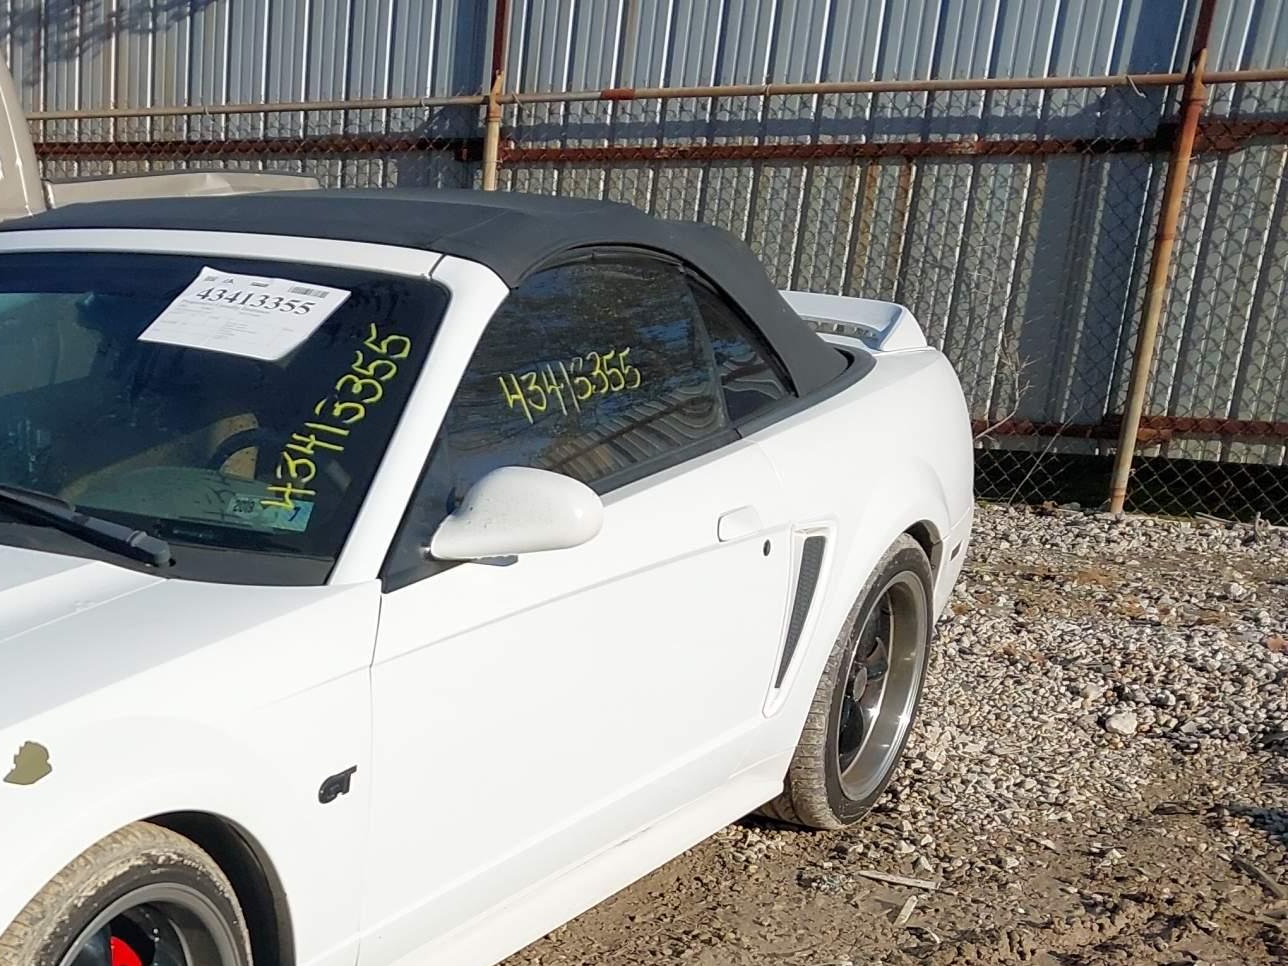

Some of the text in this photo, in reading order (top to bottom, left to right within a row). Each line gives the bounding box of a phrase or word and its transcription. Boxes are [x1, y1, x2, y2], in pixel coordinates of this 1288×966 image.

[195, 286, 317, 316] 43413355
[498, 346, 642, 425] 43413355
[260, 322, 413, 512] 43413355
[318, 764, 358, 804] GT
